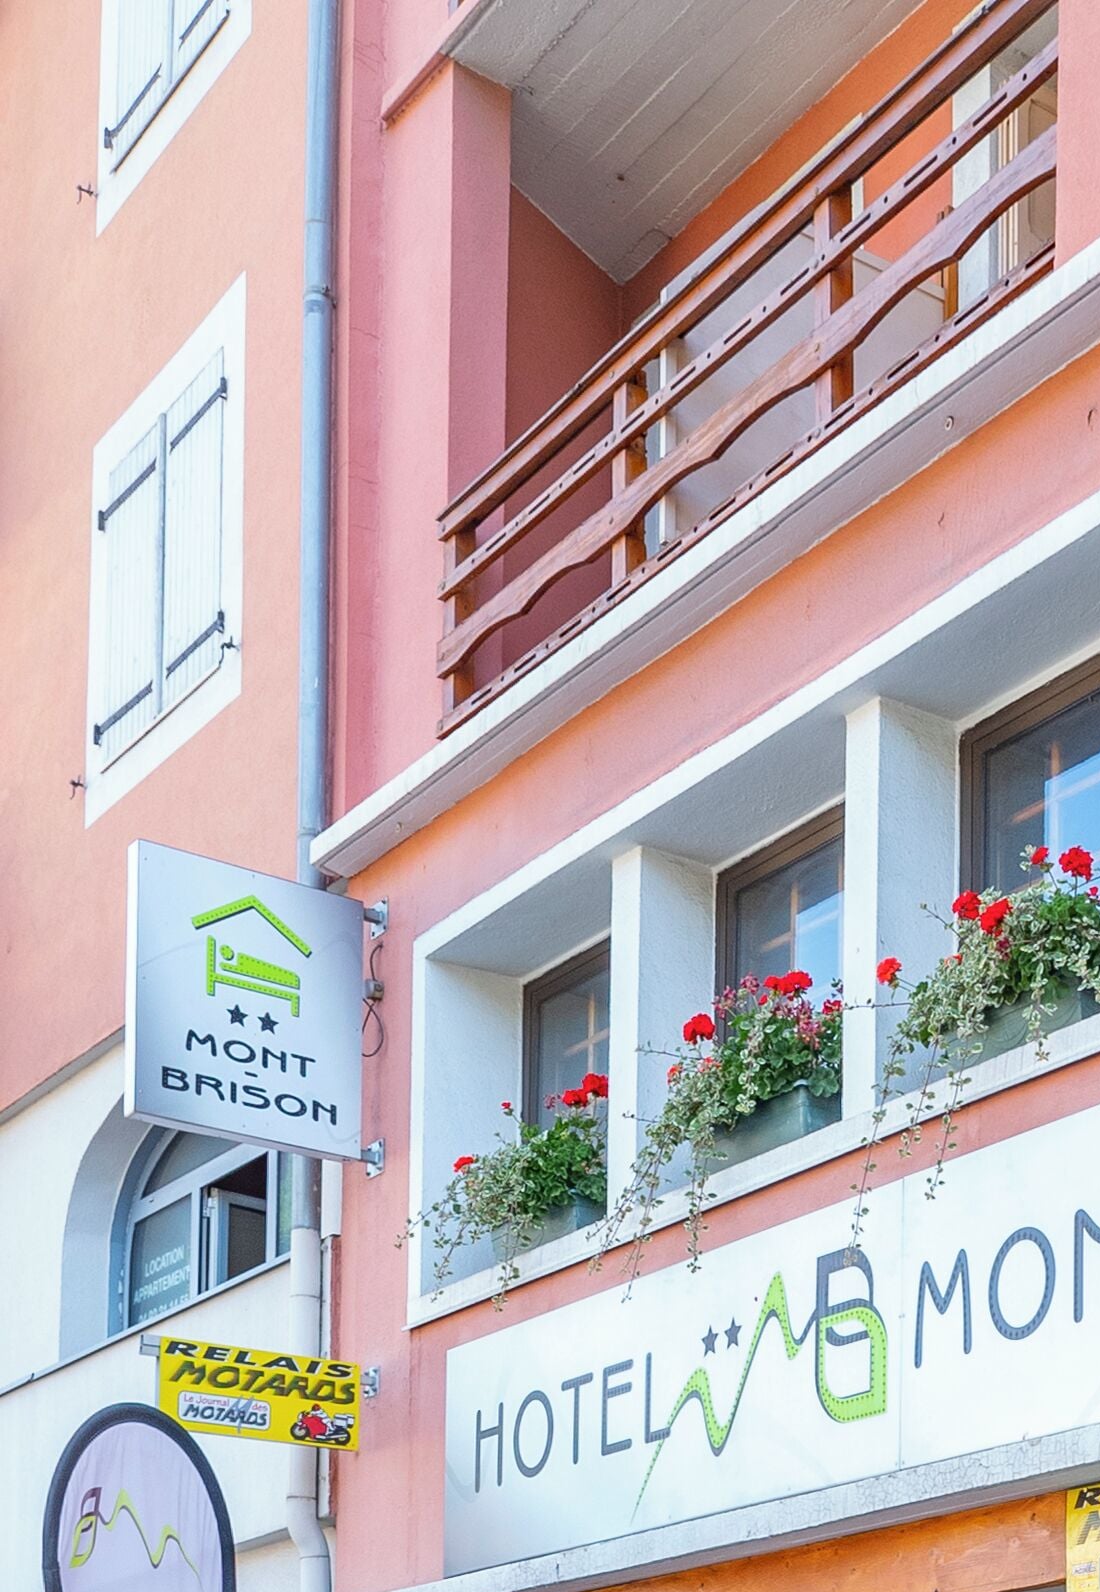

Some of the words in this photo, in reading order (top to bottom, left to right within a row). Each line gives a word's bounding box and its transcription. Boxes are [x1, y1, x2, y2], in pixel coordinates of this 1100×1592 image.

[185, 1029, 316, 1078] MONT
[161, 1066, 338, 1126] BRISON
[144, 1244, 186, 1278] LOCATION
[164, 1340, 353, 1379] RELAIS
[168, 1360, 356, 1405] MOTARDS
[182, 1403, 268, 1427] MOTARDS
[474, 1351, 671, 1494] HOTEL
